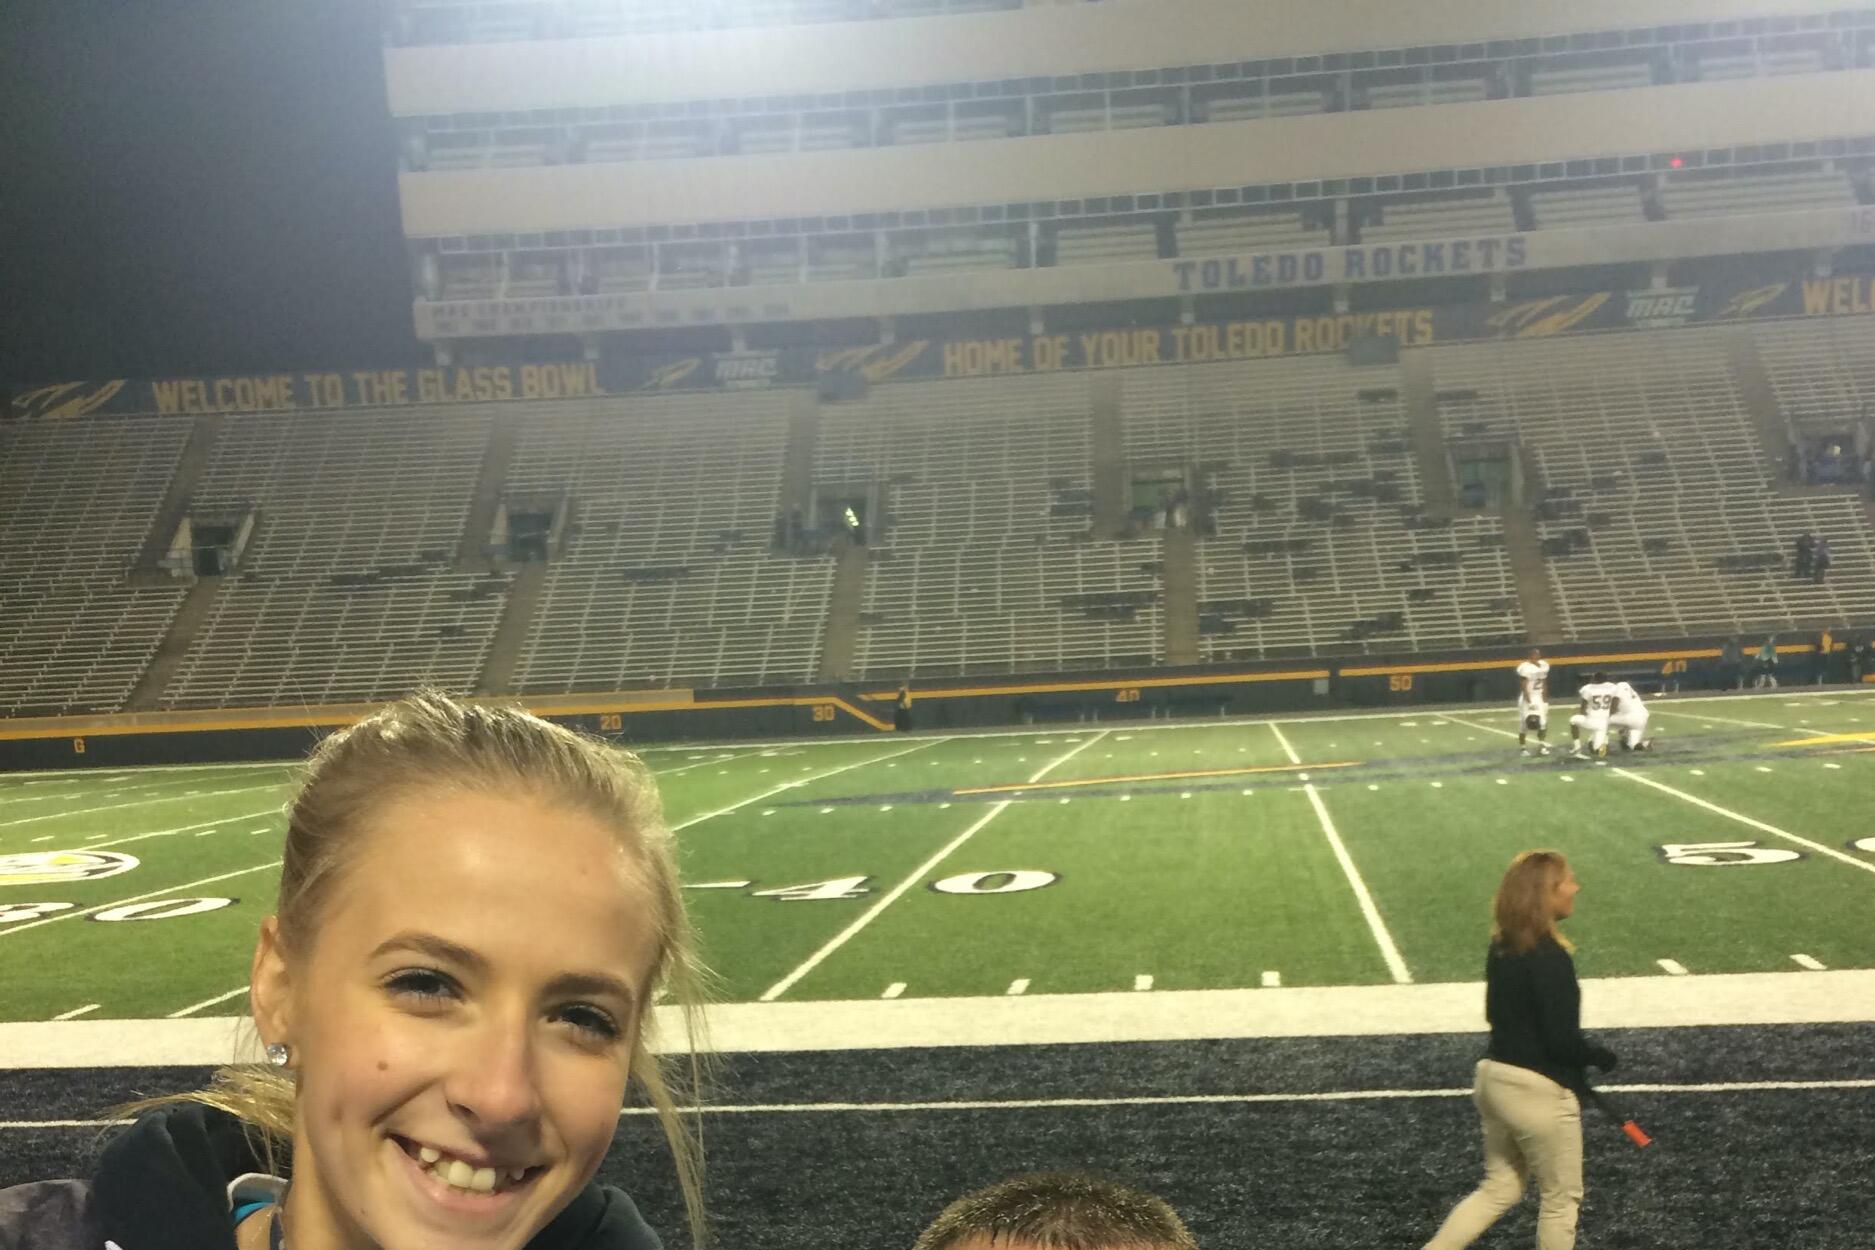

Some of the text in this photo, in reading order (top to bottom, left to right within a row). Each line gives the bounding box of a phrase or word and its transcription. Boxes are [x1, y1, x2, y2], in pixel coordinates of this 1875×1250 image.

[1173, 236, 1527, 290] TOLEDO ROCKETS
[1803, 278, 1875, 315] WEL
[943, 337, 1024, 378] HOME
[1033, 333, 1070, 371] OF
[1081, 326, 1160, 367] YOUR
[1172, 319, 1285, 361] TOLEDO
[152, 360, 605, 415] WELCOME TO THE GLASS BOWL
[1389, 674, 1413, 692] 50
[812, 705, 835, 722] 30
[1592, 693, 1613, 710] 59
[600, 713, 623, 730] 20
